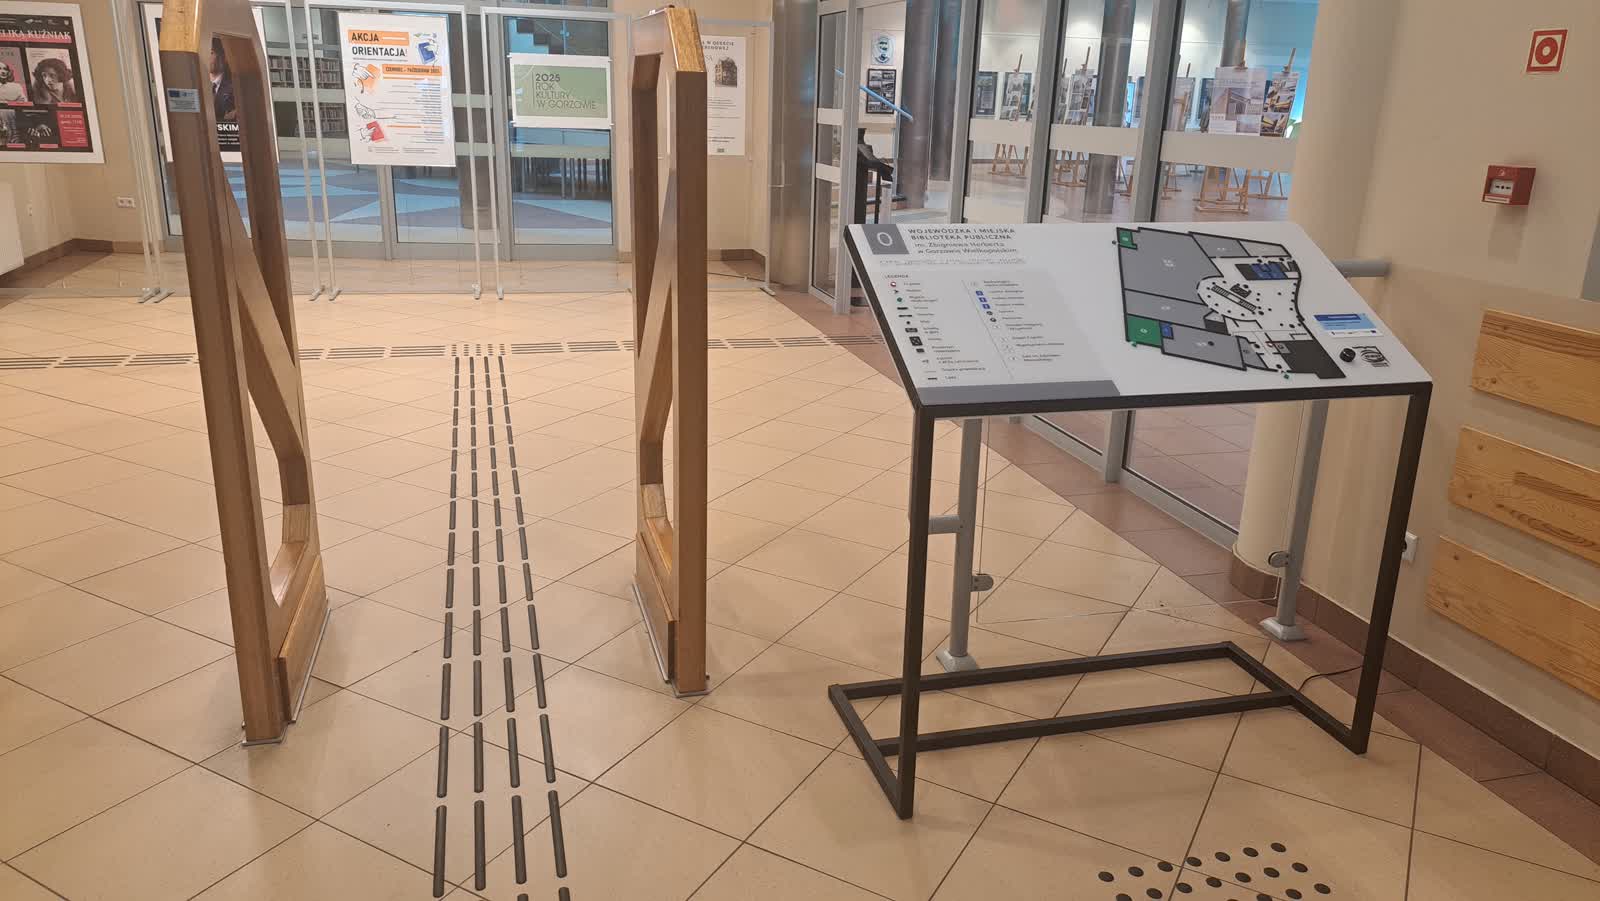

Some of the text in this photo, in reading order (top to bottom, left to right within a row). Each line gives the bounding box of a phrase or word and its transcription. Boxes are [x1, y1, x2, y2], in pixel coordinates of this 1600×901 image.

[0, 29, 70, 39] LIKA KUŹNIAK
[351, 32, 380, 42] AKCJA
[351, 46, 408, 57] ORIENTACJA!
[535, 73, 560, 82] 2025
[535, 82, 555, 91] ROK
[535, 91, 570, 100] KULTURY
[536, 100, 598, 109] W GORZOWIE
[217, 123, 240, 132] SKIM
